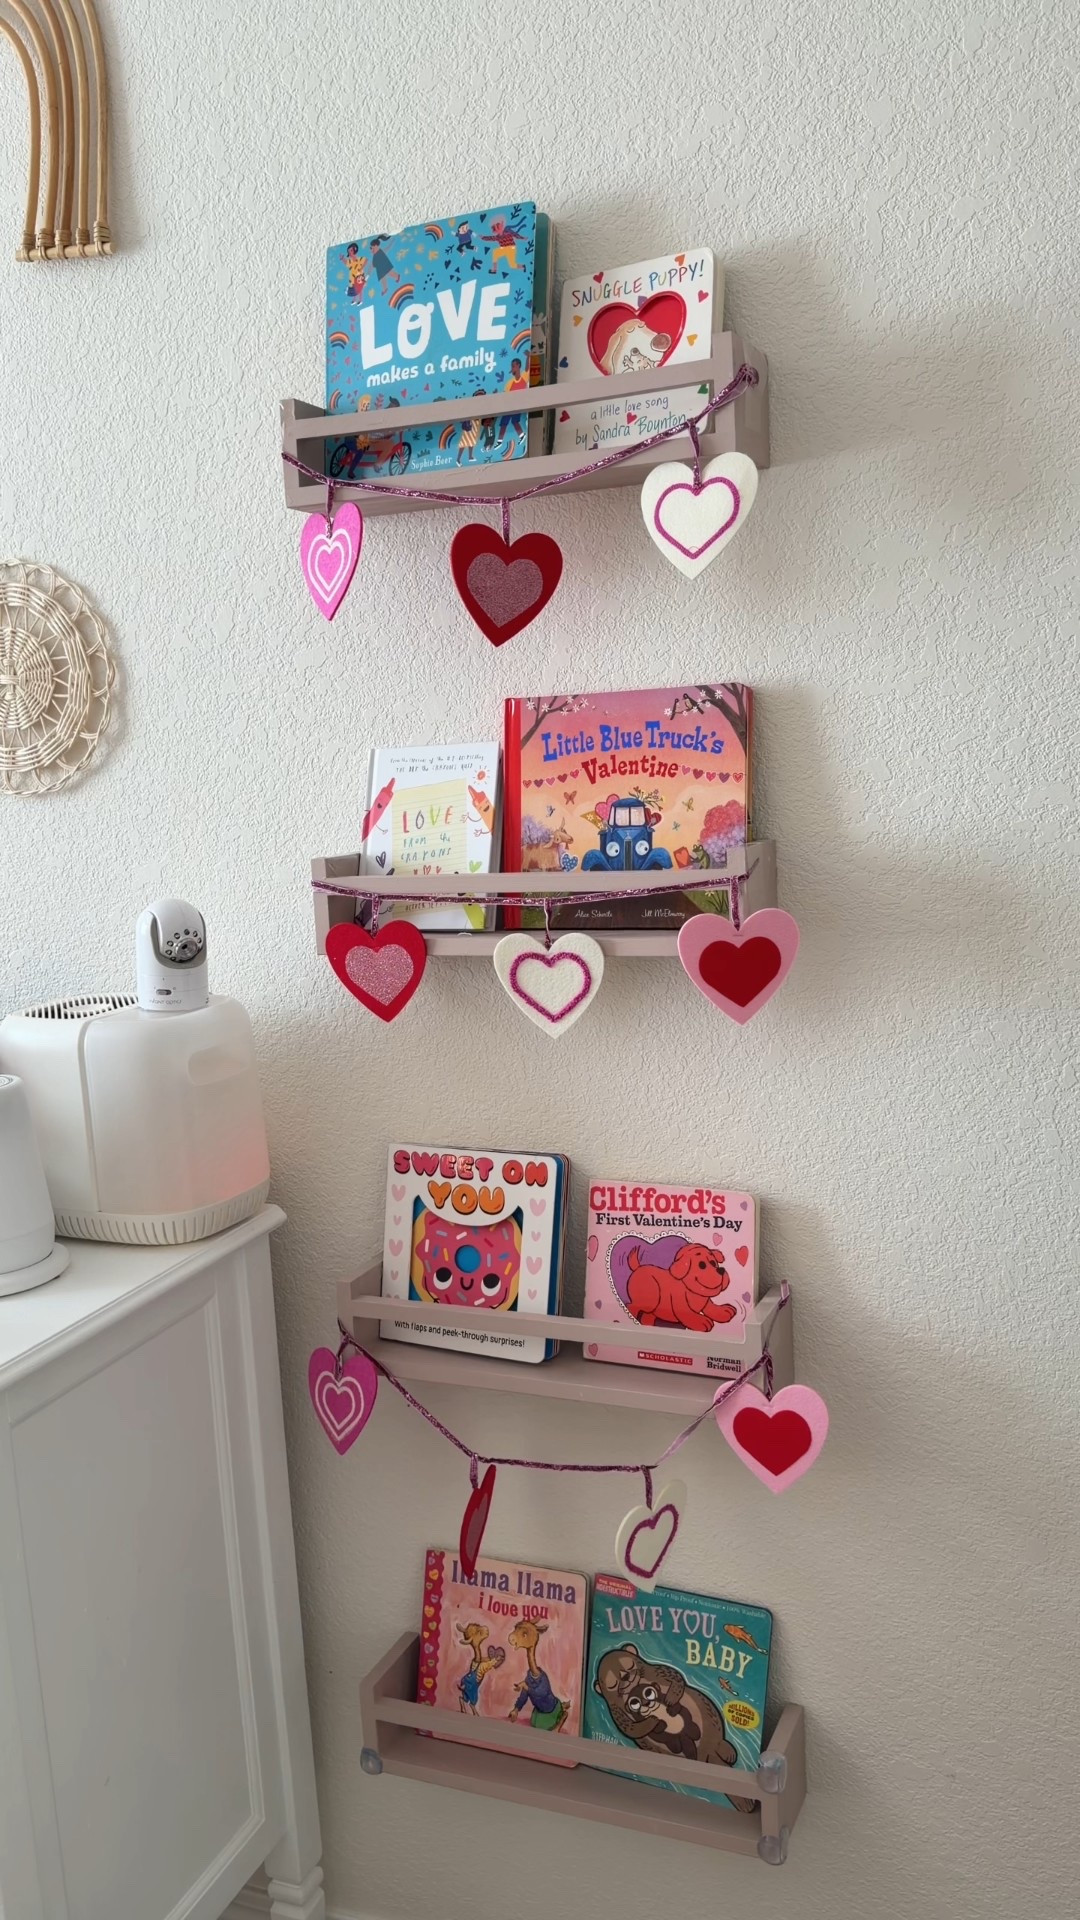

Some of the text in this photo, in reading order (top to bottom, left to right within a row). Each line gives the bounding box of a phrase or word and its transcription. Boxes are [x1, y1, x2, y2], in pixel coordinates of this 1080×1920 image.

[572, 259, 705, 307] SNUGGLE PUPPY!
[359, 279, 511, 370] LOVE
[367, 347, 497, 388] makes a family
[591, 396, 669, 421] a little love song
[575, 411, 686, 449] by Sandra Boynton
[411, 455, 453, 472] Sophie Beer
[541, 720, 725, 763] Little Blue Truck's
[581, 754, 680, 786] Valentine
[403, 804, 453, 833] LOVE
[400, 847, 451, 864] CRAYONS
[393, 1150, 548, 1187] SWEET ON
[427, 1180, 505, 1216] YOU
[590, 1185, 726, 1215] Clifford's
[596, 1212, 743, 1233] First Valentine's Day
[394, 1320, 525, 1348] With flaps and peek-through surprises!
[644, 1353, 692, 1365] SCHOLASTIC
[707, 1356, 742, 1365] Norman
[707, 1361, 742, 1373] Bridwell
[451, 1560, 576, 1605] llama llama
[478, 1591, 549, 1621] i love you
[605, 1605, 663, 1633] LOVE
[685, 1638, 753, 1679] BABY
[728, 1704, 755, 1717] MILLIONS
[731, 1714, 750, 1727] SOLD!
[735, 1711, 754, 1721] COPIES
